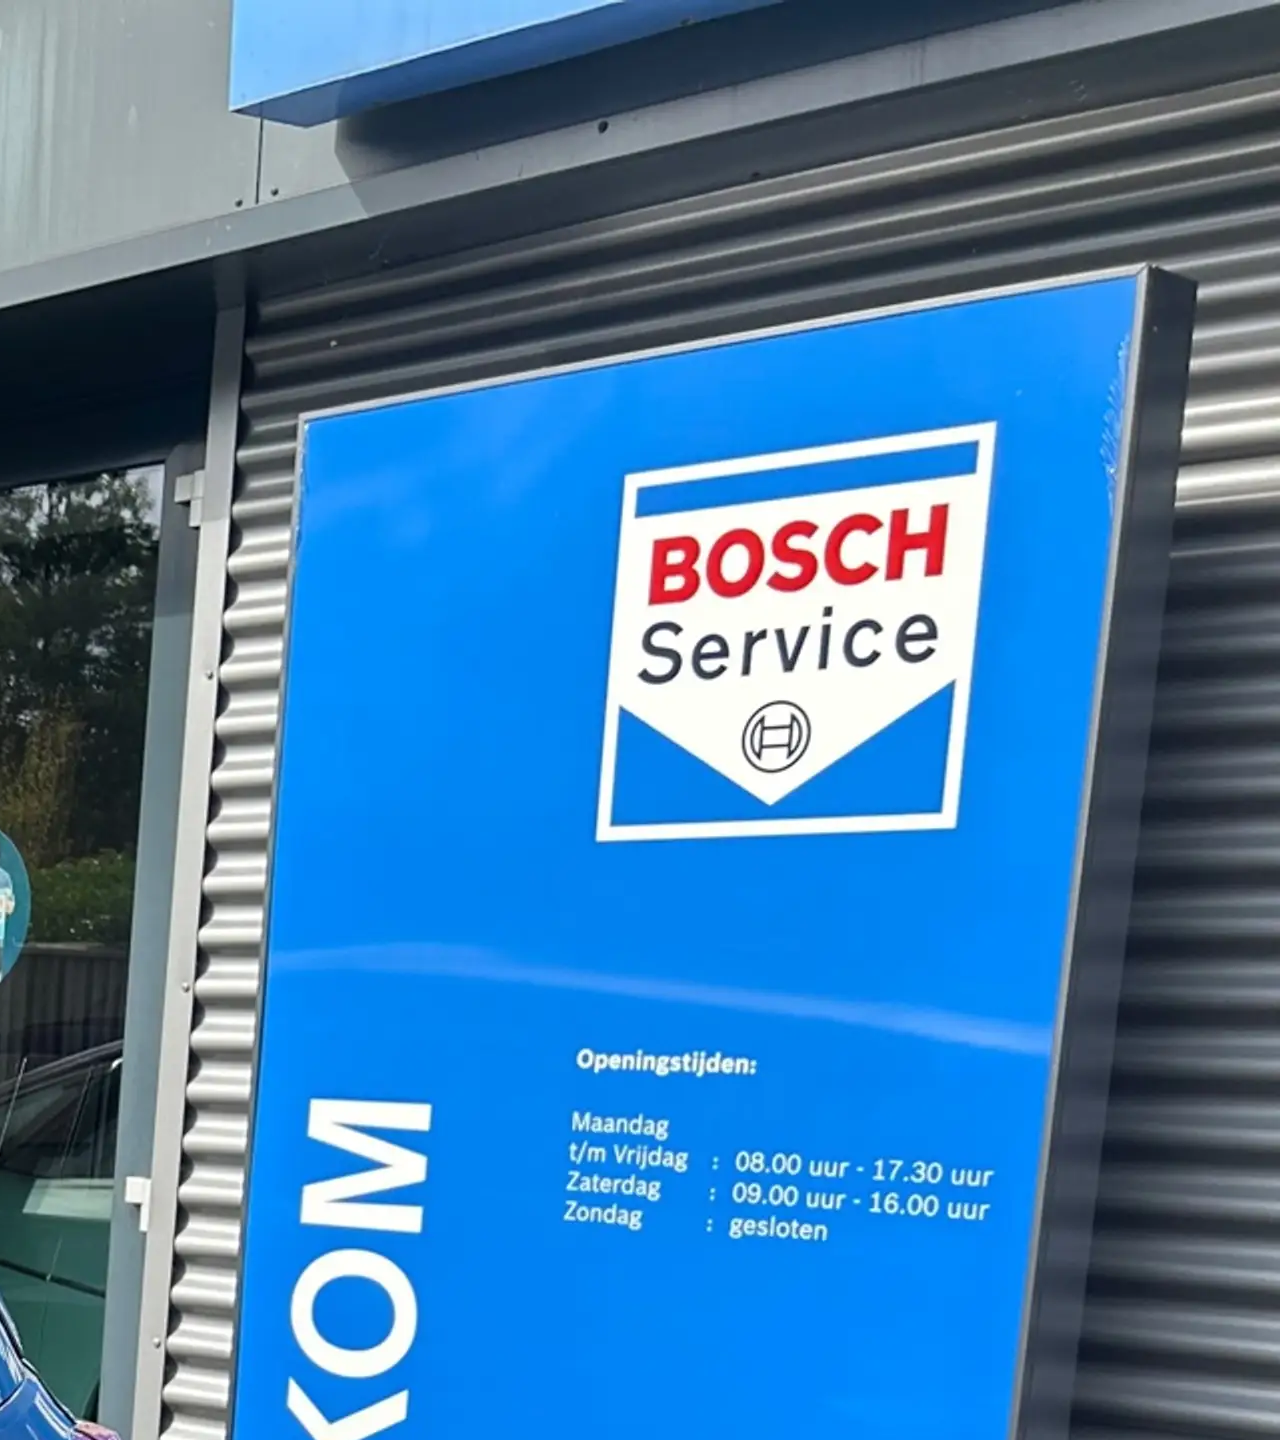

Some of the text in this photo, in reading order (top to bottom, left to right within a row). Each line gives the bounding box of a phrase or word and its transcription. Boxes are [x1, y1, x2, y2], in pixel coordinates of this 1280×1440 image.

[648, 503, 950, 606] BOSCH
[637, 605, 939, 685] Service
[576, 1047, 757, 1076] Openingstijden:
[571, 1111, 670, 1141] Maandag
[568, 1141, 606, 1165] t/m
[613, 1143, 689, 1172] Vrijdag
[735, 1150, 802, 1176] 08.00
[809, 1158, 850, 1178] uur
[872, 1159, 943, 1184] 17.30
[950, 1167, 994, 1188] uur
[566, 1171, 661, 1201] Zaterdag
[732, 1182, 799, 1207] 09.00
[805, 1190, 846, 1210] uur
[869, 1191, 940, 1218] 16.00
[947, 1200, 990, 1221] uur
[563, 1201, 643, 1230] Zondag
[729, 1215, 828, 1242] gesloten
